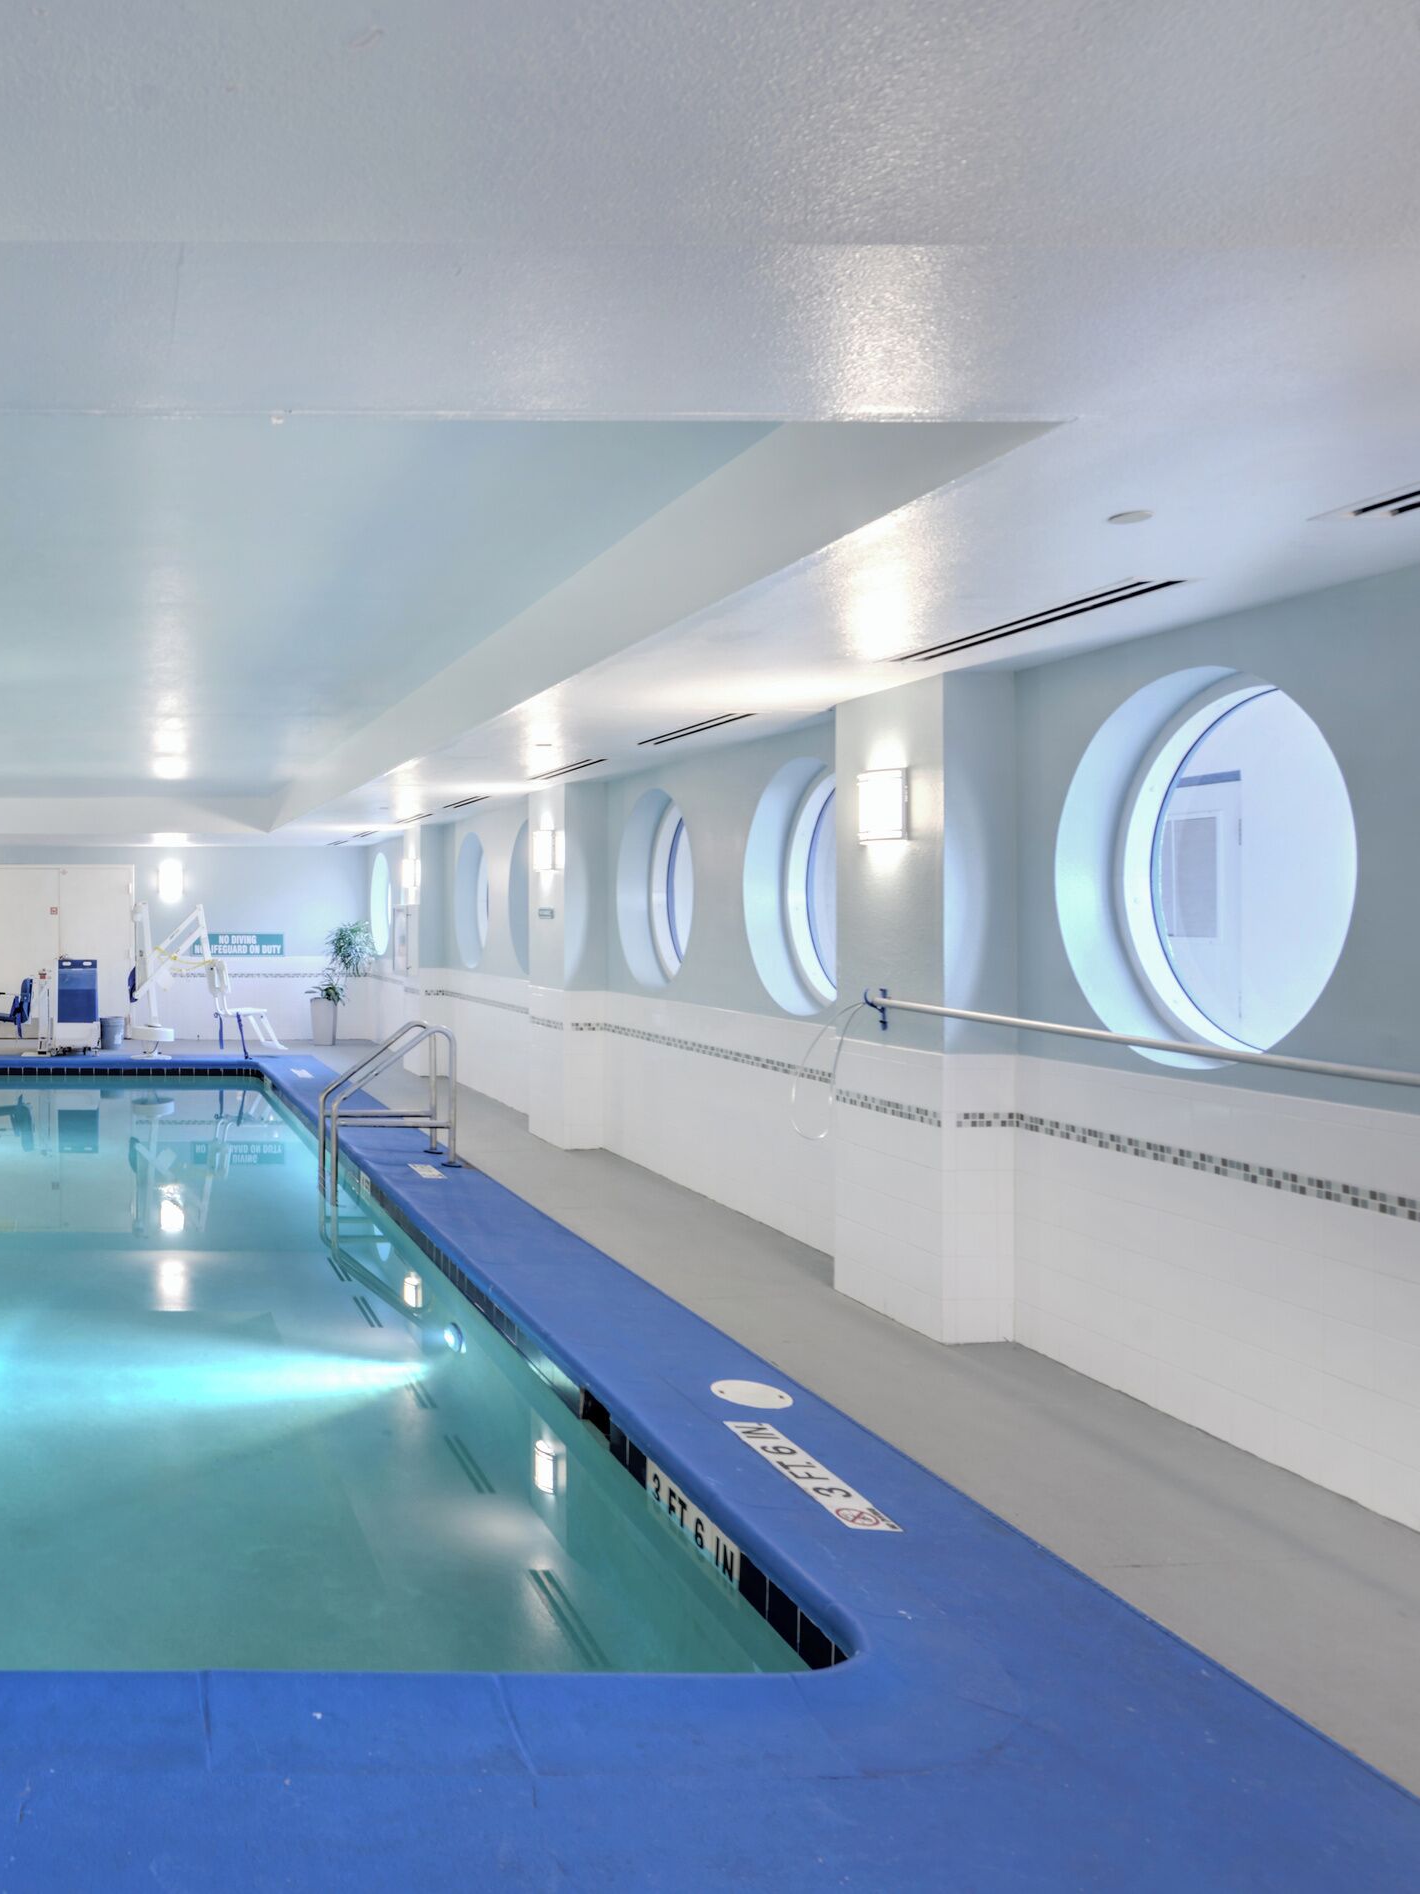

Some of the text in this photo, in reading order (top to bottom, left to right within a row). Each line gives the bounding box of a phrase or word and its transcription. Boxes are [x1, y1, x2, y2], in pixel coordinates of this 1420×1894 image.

[218, 934, 258, 944] NO DIVING
[211, 944, 248, 954] IFEGUARD
[249, 944, 261, 954] ON
[261, 944, 282, 954] DUTY
[760, 1445, 797, 1456] 6
[812, 1486, 853, 1499] 3
[652, 1473, 734, 1583] 3 FT 6 IN
